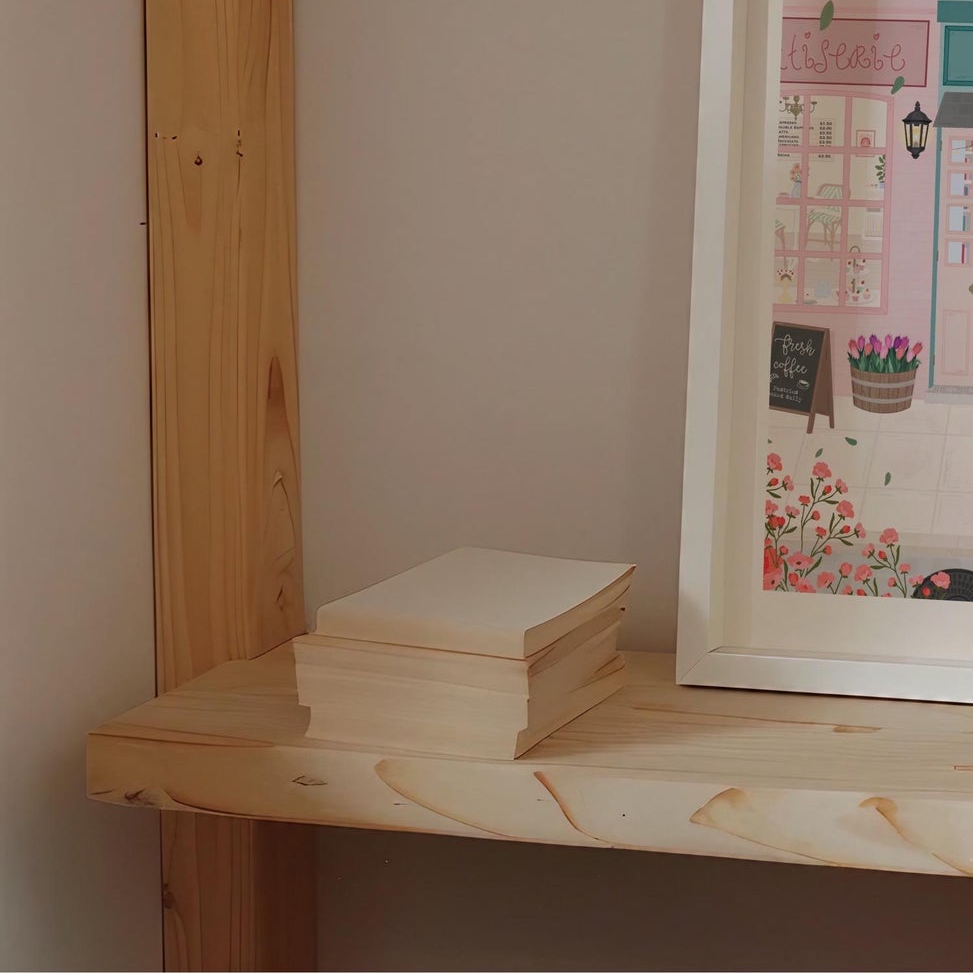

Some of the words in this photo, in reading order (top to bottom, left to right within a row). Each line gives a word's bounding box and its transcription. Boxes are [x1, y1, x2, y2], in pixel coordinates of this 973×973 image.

[780, 30, 906, 74] tiserie
[774, 334, 815, 356] fresh
[773, 356, 808, 378] coffee
